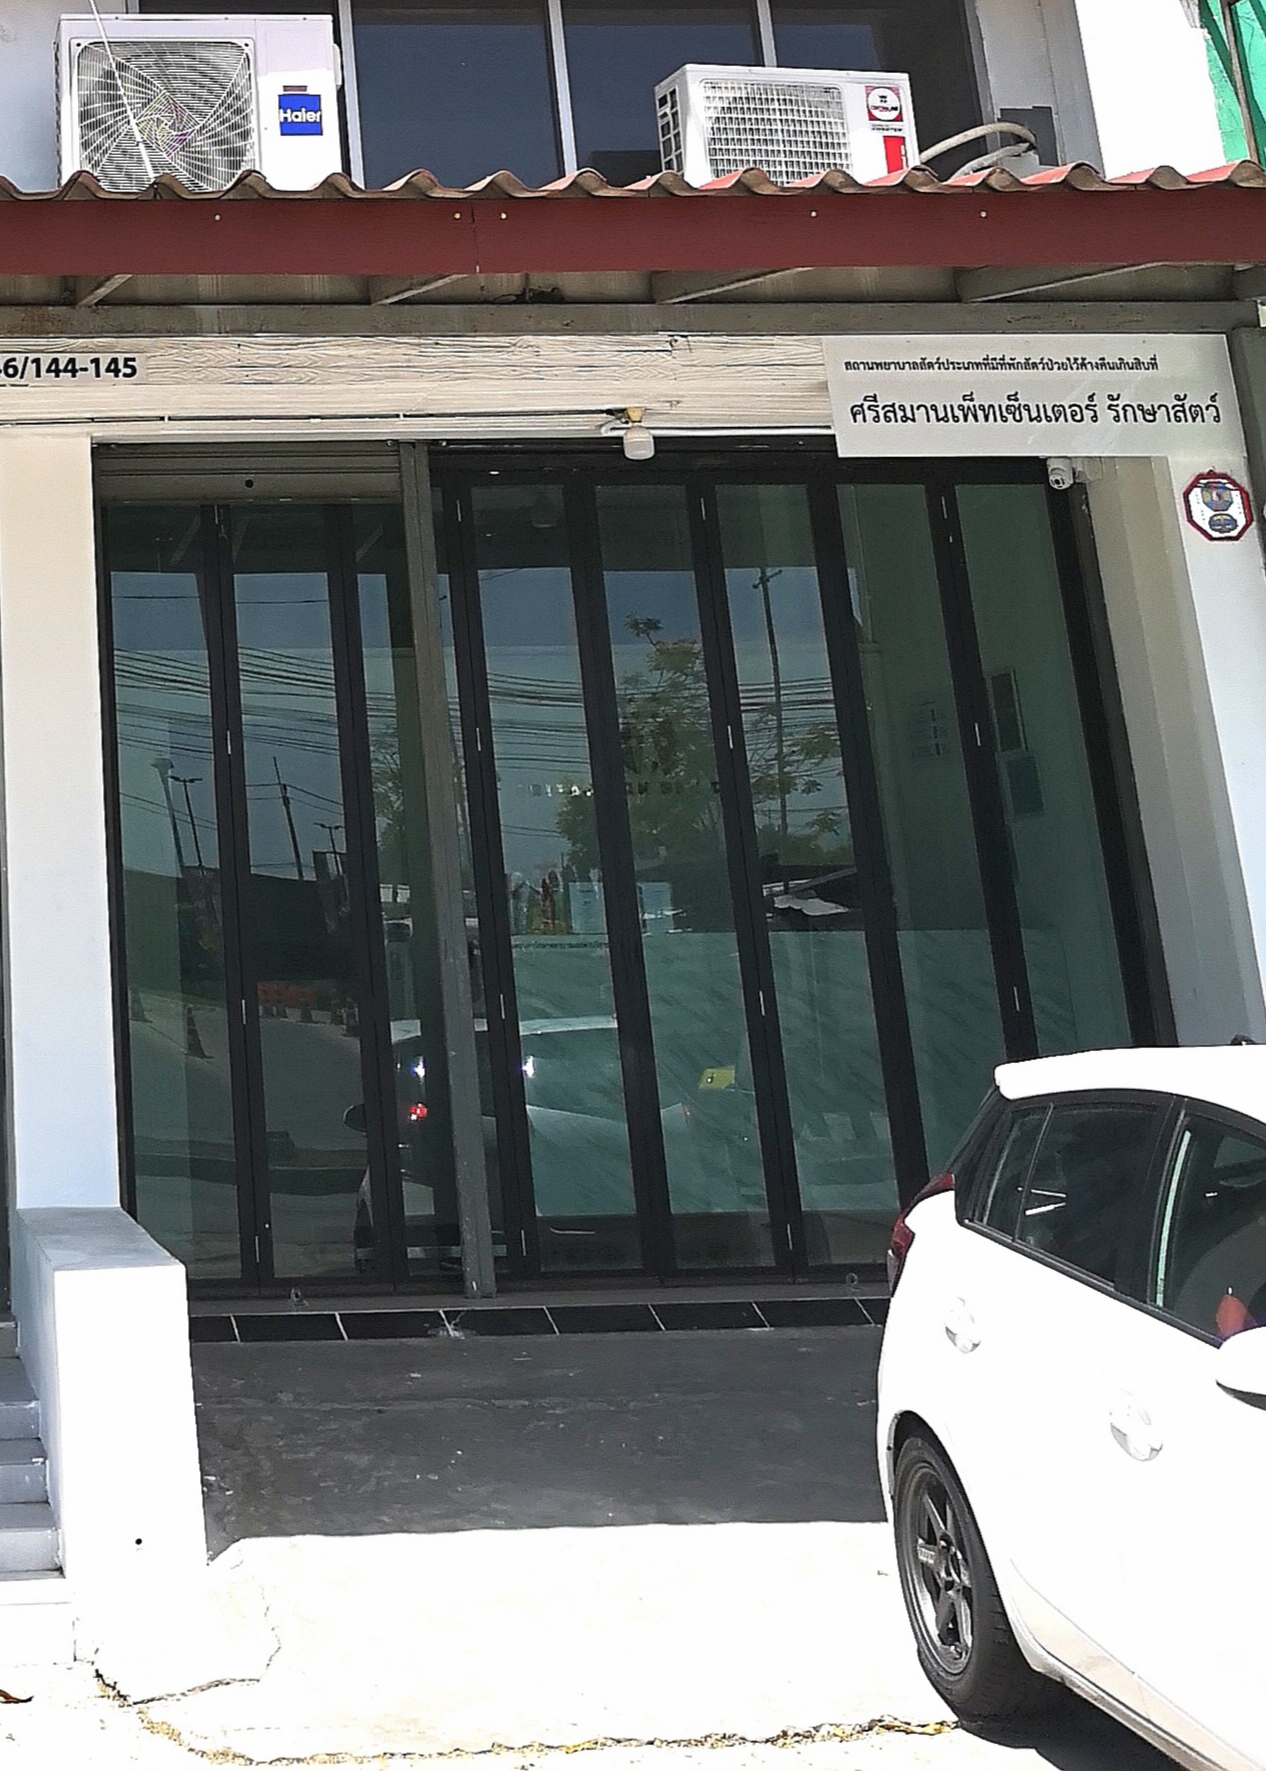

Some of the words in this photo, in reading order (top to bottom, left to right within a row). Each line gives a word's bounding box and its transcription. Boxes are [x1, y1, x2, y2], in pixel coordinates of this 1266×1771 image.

[278, 107, 322, 123] Haier
[849, 391, 1099, 424] ศรีสมานเพ็ทเซ็นเตอร์
[1106, 392, 1222, 425] รักษาสัตว์
